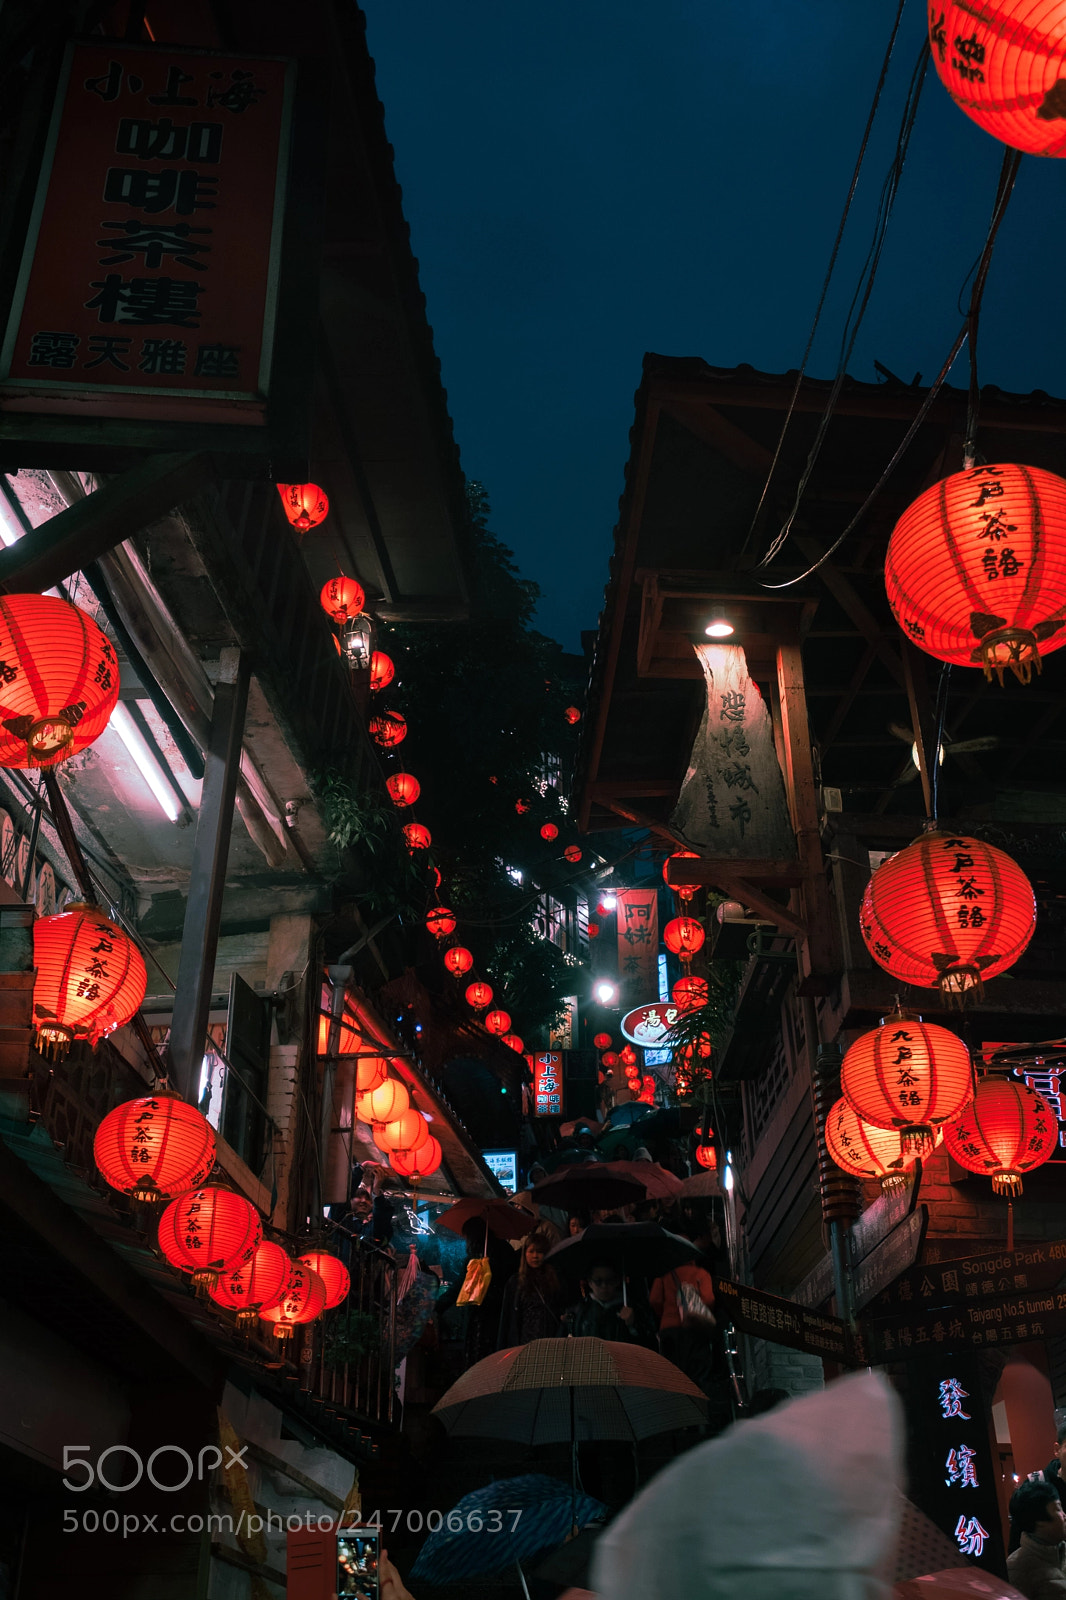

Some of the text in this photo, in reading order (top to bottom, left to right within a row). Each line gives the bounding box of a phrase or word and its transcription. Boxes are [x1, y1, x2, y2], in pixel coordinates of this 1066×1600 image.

[84, 60, 267, 114] 小上海
[83, 117, 224, 329] 咖啡茶樓
[26, 331, 242, 378] 露天雅座
[642, 1008, 679, 1027] 湯包
[539, 1053, 560, 1092] 小上海
[962, 1255, 1012, 1277] Songde
[1014, 1247, 1046, 1267] Park
[967, 1305, 1003, 1325] Taiyang
[1003, 1301, 1026, 1318] No.5
[1026, 1296, 1055, 1315] tunnel
